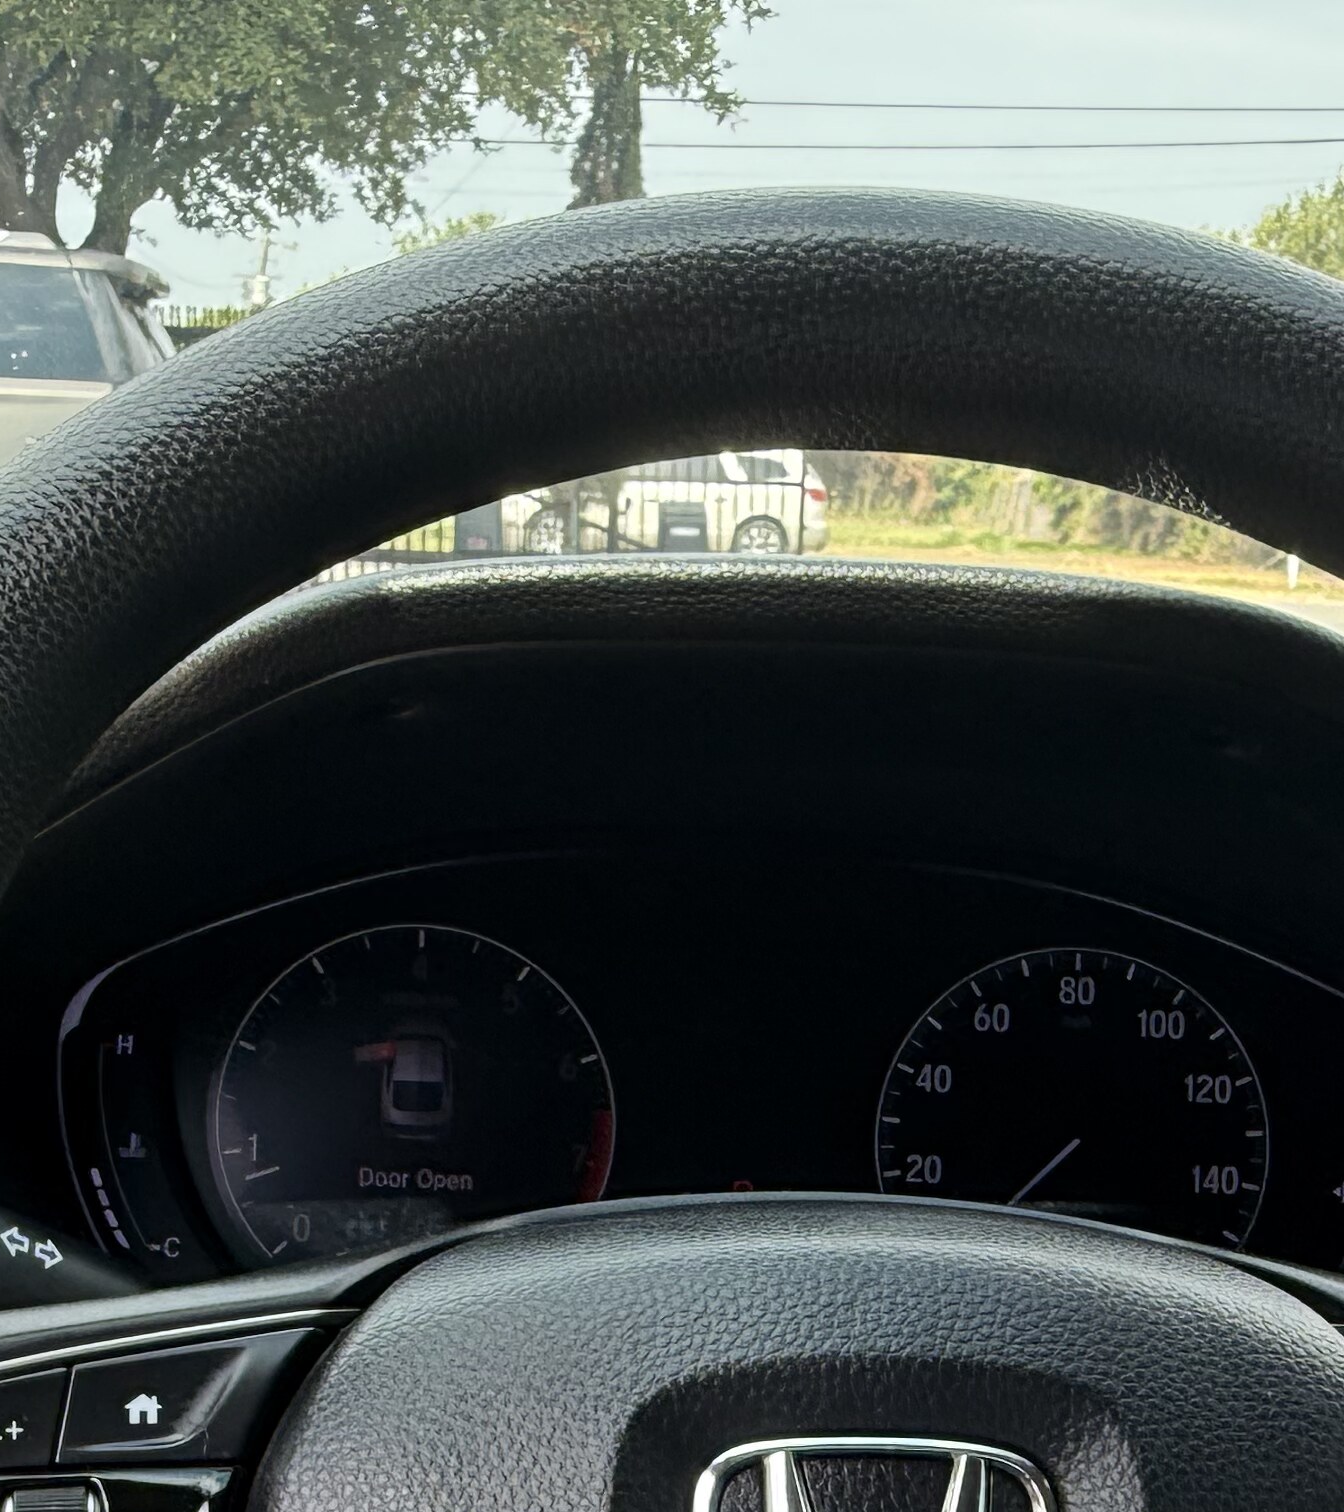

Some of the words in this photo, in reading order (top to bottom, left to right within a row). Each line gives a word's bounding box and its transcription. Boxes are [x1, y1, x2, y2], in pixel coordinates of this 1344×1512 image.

[1058, 976, 1096, 1005] 80
[973, 1003, 1011, 1033] 60
[1137, 1009, 1186, 1041] 100
[116, 1034, 135, 1056] H
[914, 1063, 953, 1094] 40
[1183, 1074, 1233, 1105] 120
[358, 1166, 411, 1190] Door
[415, 1166, 474, 1193] Open
[904, 1154, 943, 1185] 20
[1191, 1164, 1240, 1196] 140
